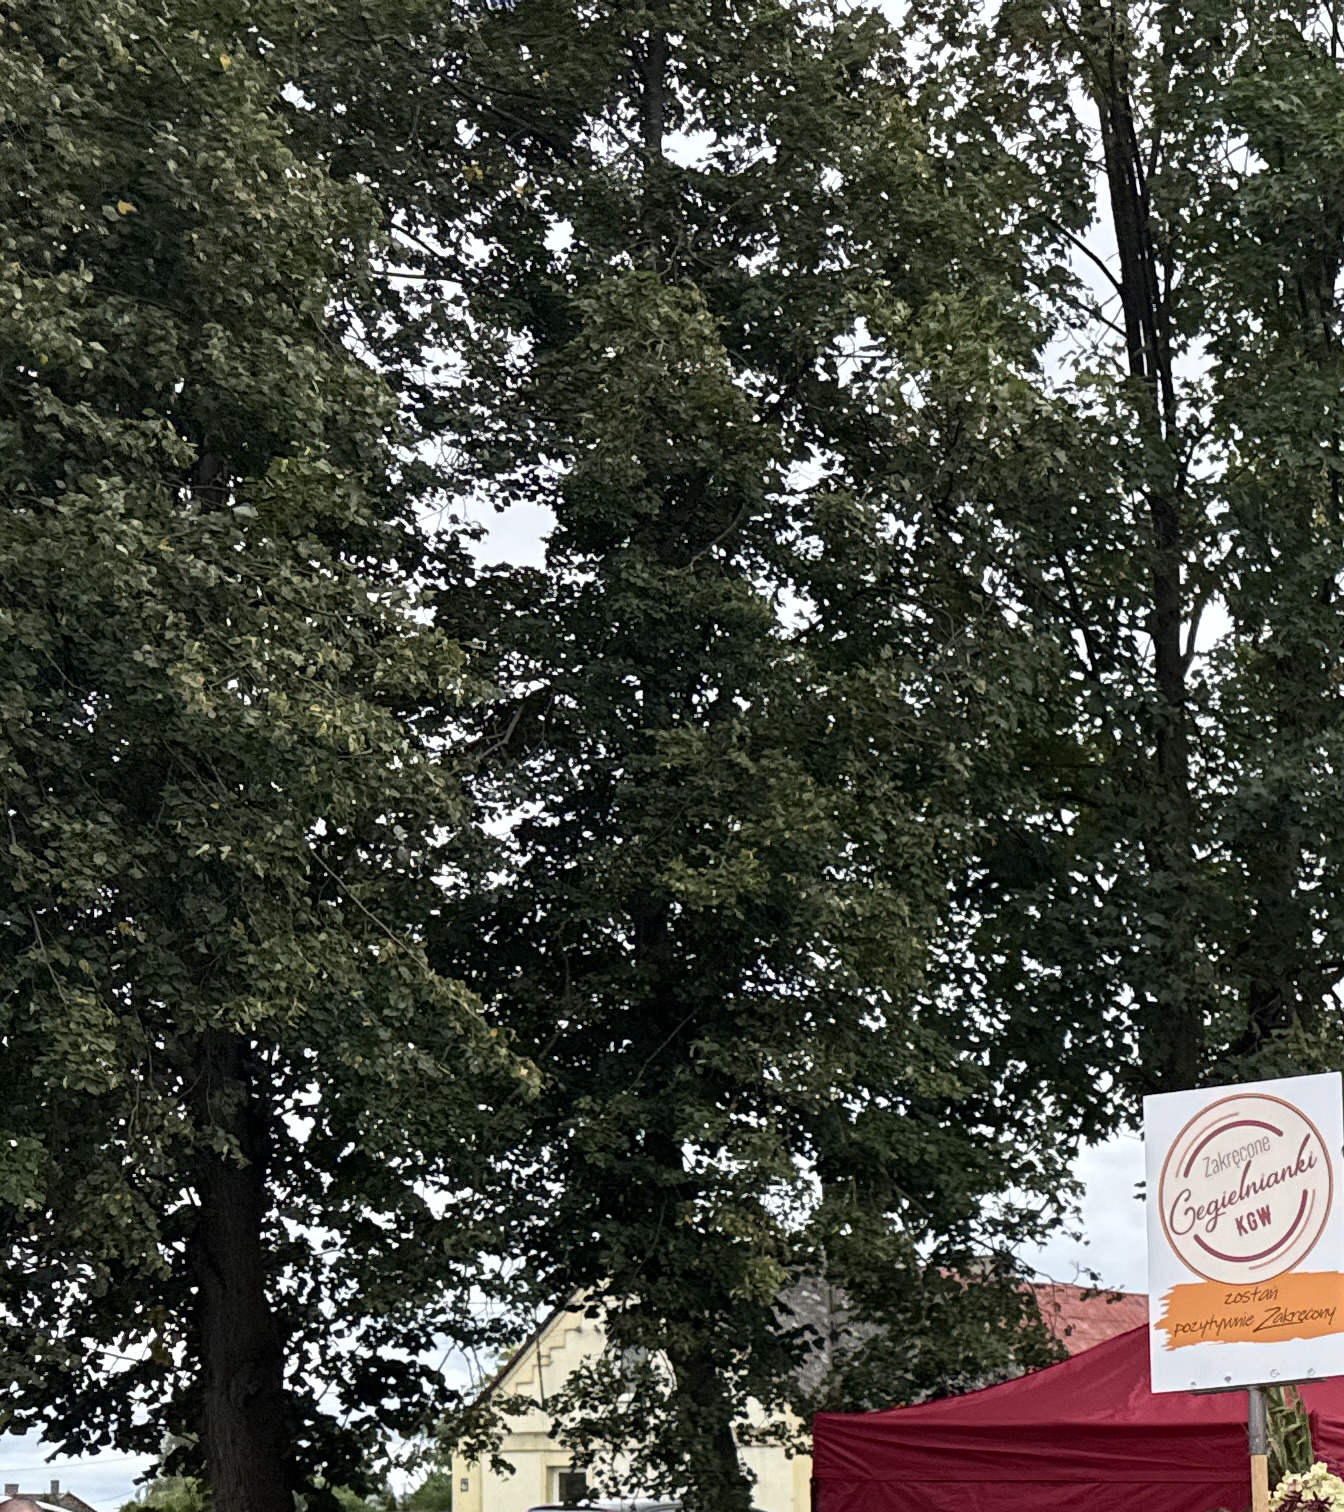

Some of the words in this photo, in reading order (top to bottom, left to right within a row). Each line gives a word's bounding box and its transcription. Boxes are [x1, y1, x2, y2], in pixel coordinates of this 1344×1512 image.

[1202, 1135, 1271, 1178] Zakręcone
[1234, 1204, 1272, 1237] KGW
[1223, 1284, 1279, 1305] zostań
[1173, 1311, 1255, 1339] pozytywnie
[1252, 1306, 1337, 1333] Zakręcony
